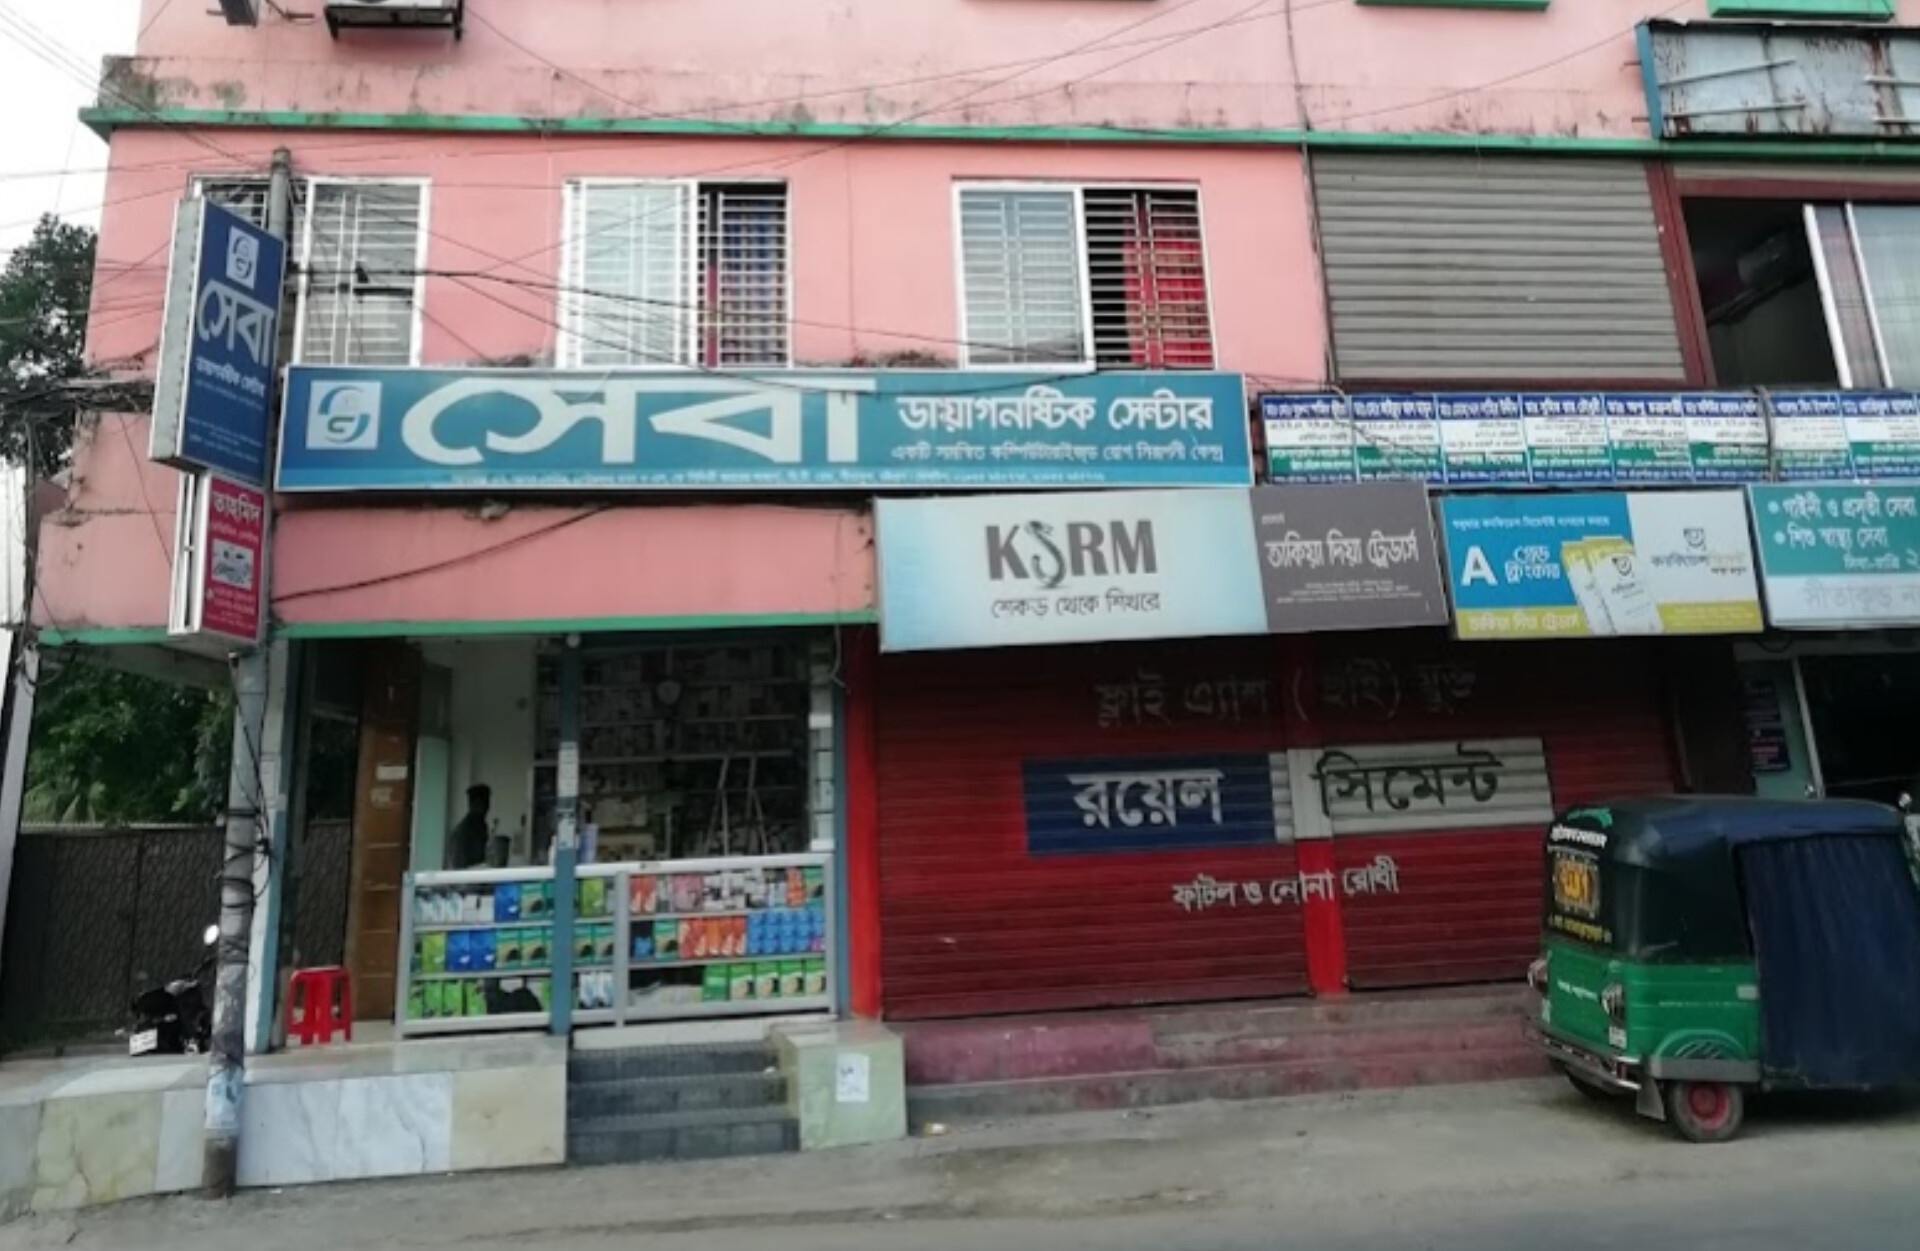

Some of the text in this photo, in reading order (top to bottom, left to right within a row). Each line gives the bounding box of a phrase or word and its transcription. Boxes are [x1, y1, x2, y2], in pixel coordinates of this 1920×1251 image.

[197, 278, 275, 368] সেবা
[402, 375, 877, 465] সেবা
[1107, 388, 1214, 431] সেন্টার
[985, 519, 1158, 589] KSRM
[1461, 545, 1499, 587] A
[1056, 593, 1099, 617] থেকে
[1066, 742, 1504, 829] রয়েল সিমেন্ট
[1243, 881, 1264, 905] ও
